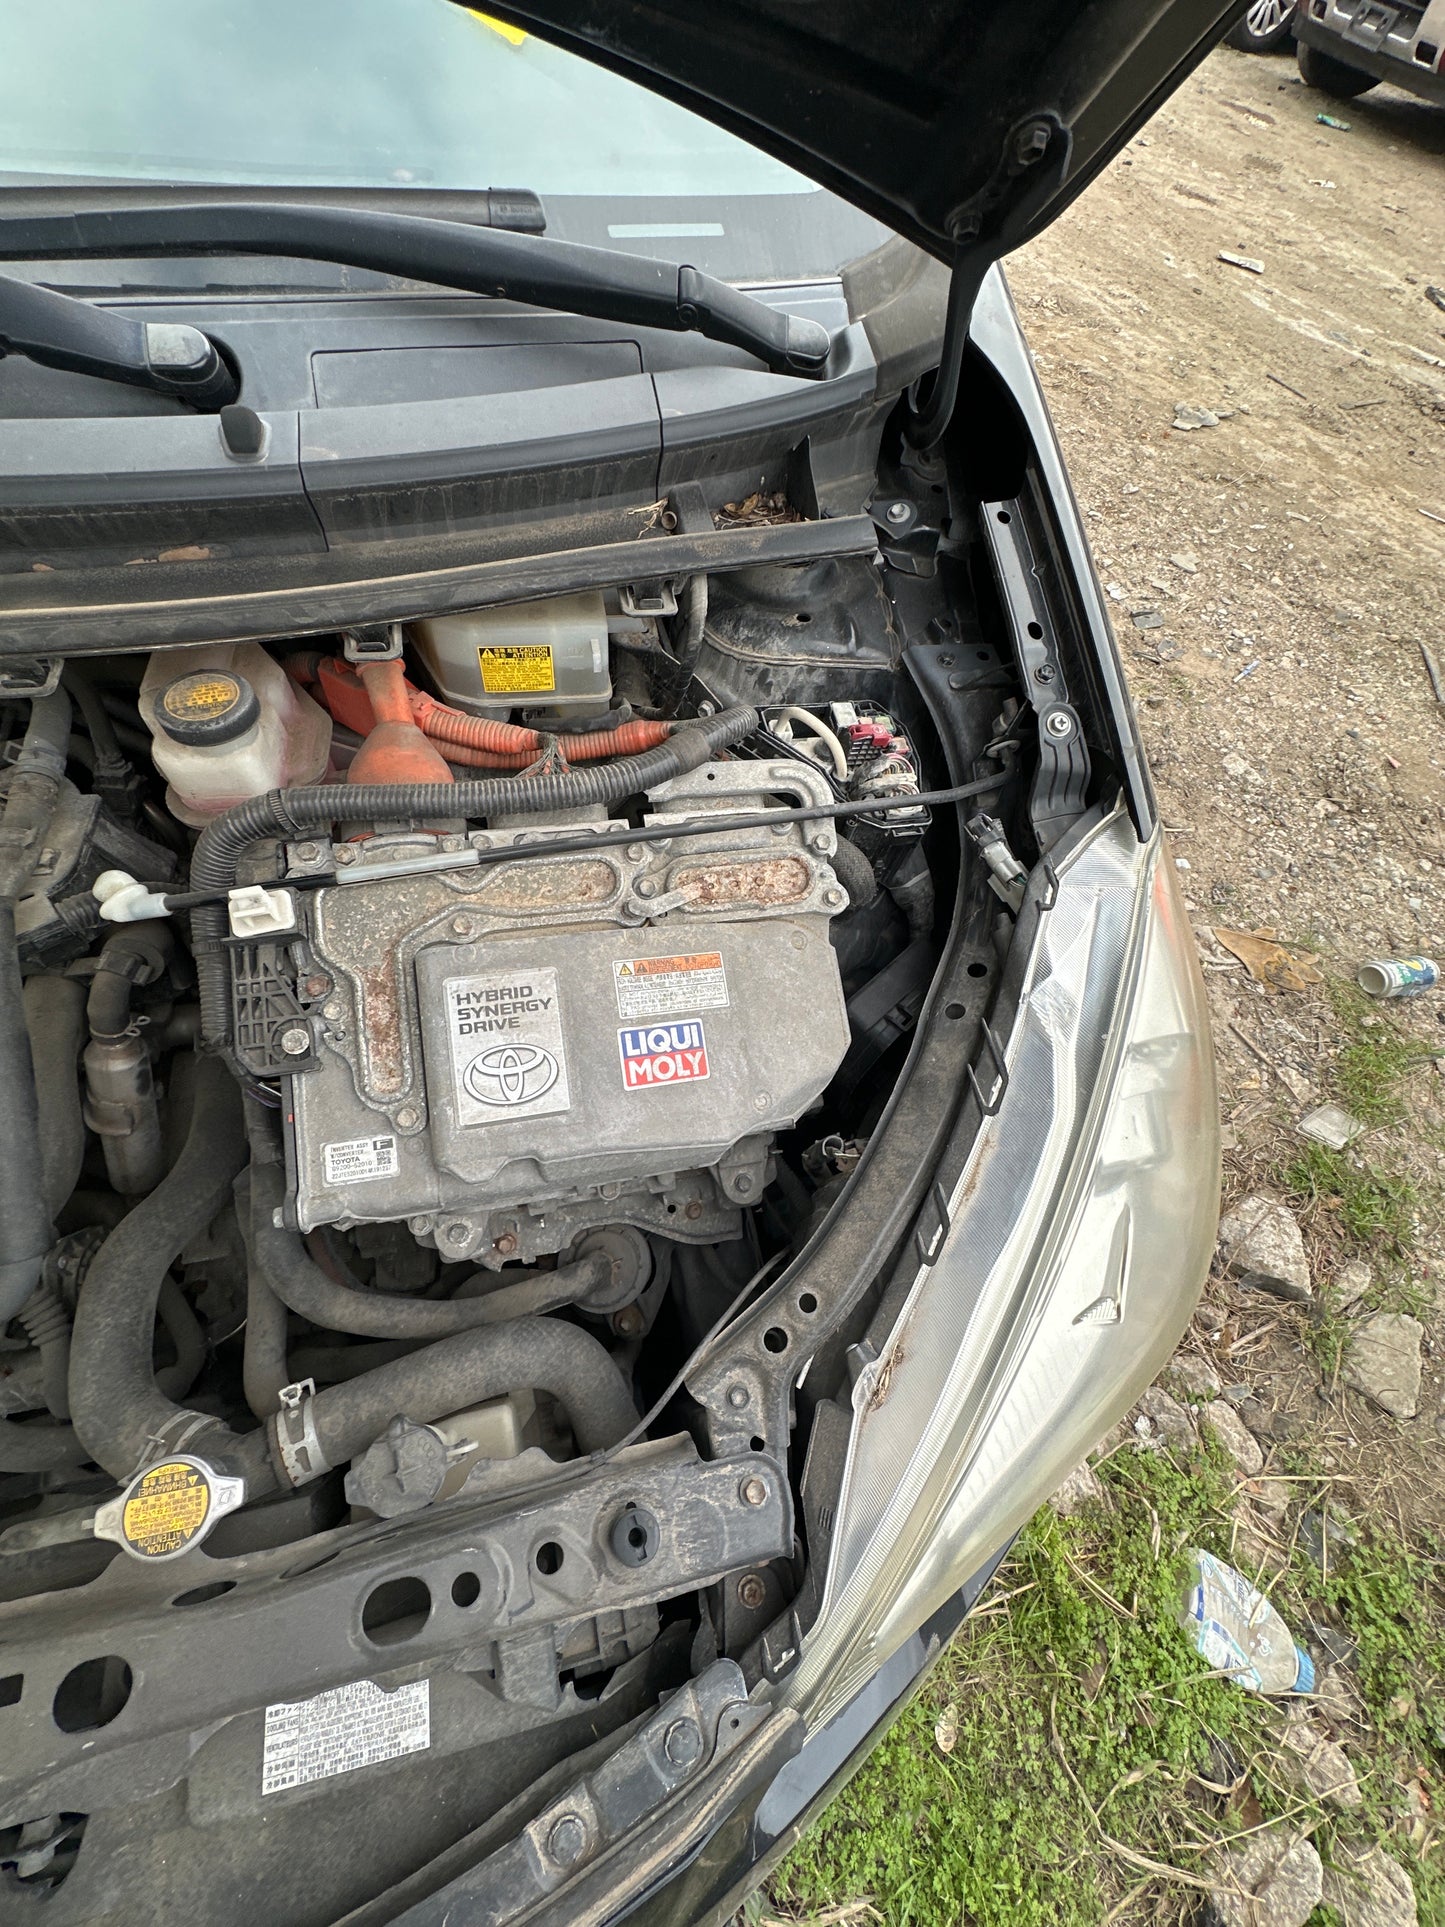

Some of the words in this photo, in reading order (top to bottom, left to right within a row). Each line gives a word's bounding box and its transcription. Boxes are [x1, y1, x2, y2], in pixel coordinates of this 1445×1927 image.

[456, 985, 533, 1006] HYBRID
[457, 997, 552, 1021] SYNERGY
[459, 1017, 521, 1035] DRIVE
[624, 1024, 701, 1056] LIQUI
[628, 1051, 704, 1085] MOLY
[330, 1143, 354, 1153] INVERTER
[331, 1156, 361, 1165] TOYOTA
[138, 1531, 182, 1547] ATTENTION
[147, 1540, 182, 1555] CAUTION
